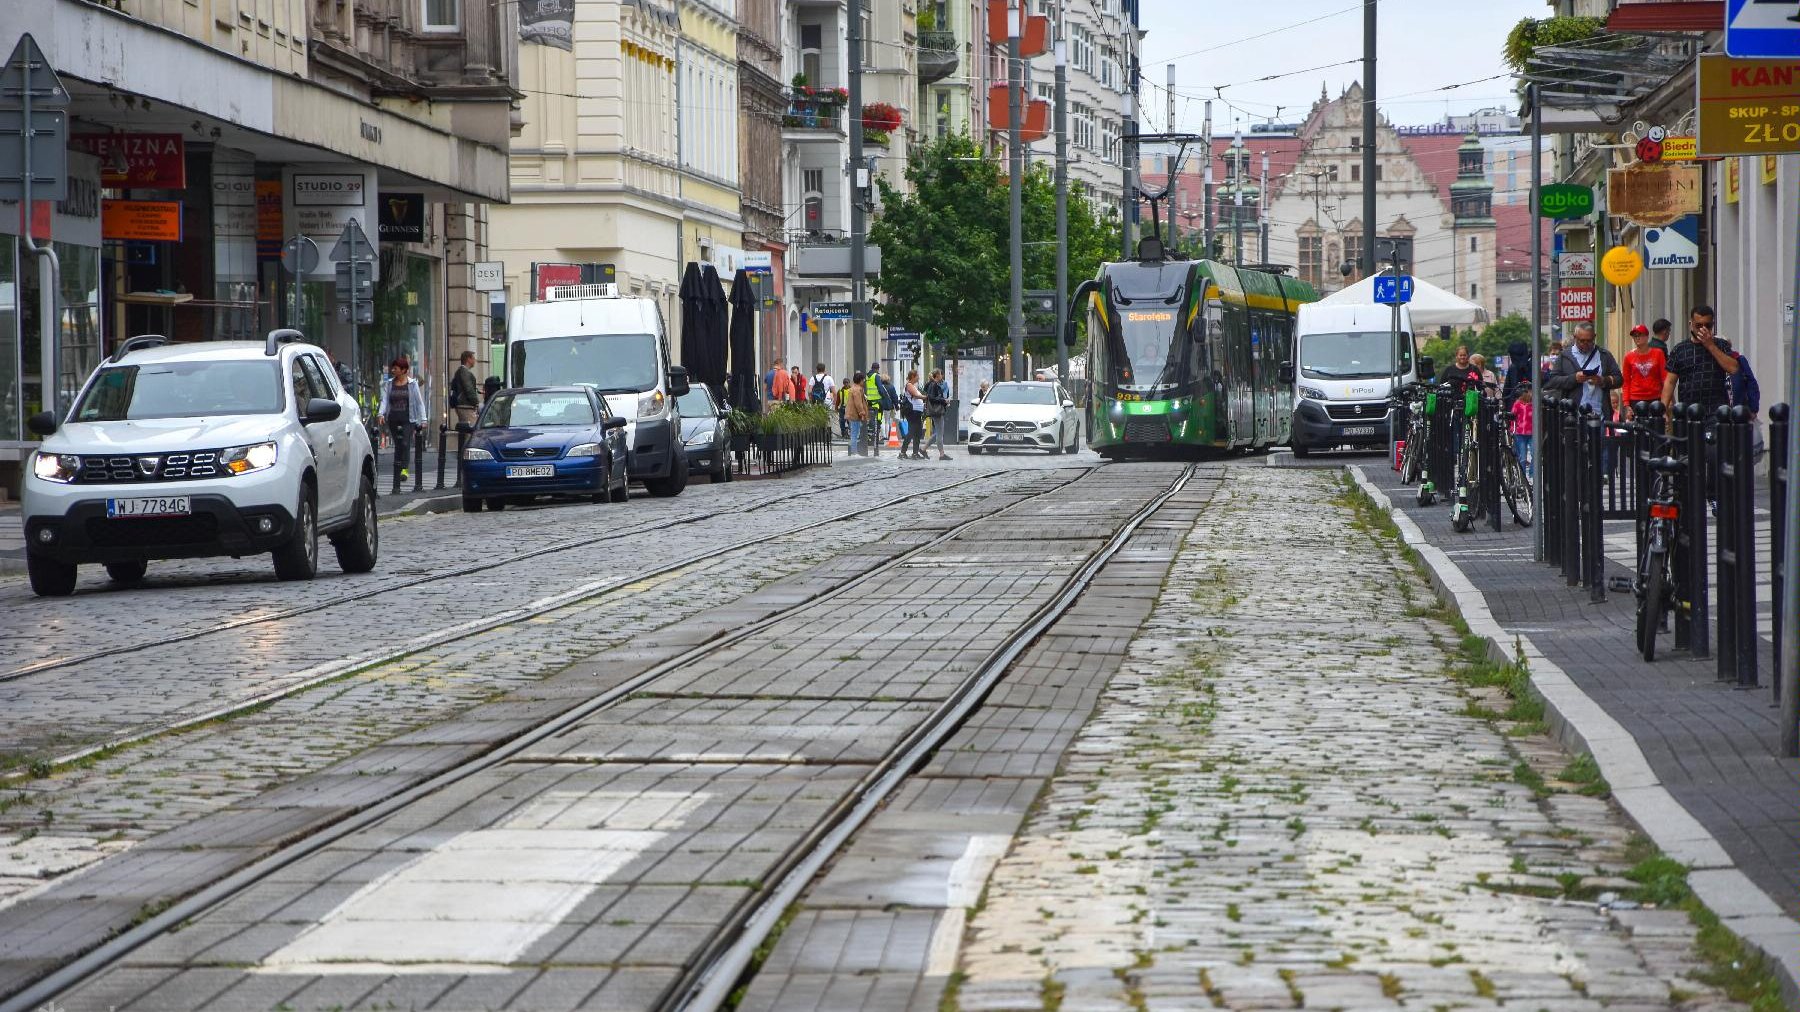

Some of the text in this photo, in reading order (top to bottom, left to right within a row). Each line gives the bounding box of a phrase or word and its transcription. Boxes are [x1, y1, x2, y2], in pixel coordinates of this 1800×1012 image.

[1729, 107, 1769, 118] SKUP
[1390, 122, 1456, 135] ercure
[102, 159, 156, 167] ASKA
[296, 182, 360, 191] STUDIO 29
[1541, 192, 1589, 206] abka
[1652, 254, 1695, 265] LAVAZZA
[1561, 290, 1593, 303] DÖNER
[1561, 305, 1593, 319] KEBAP
[1116, 392, 1141, 401] 934
[512, 468, 523, 476] PO
[117, 498, 186, 514] WJ 7784G
